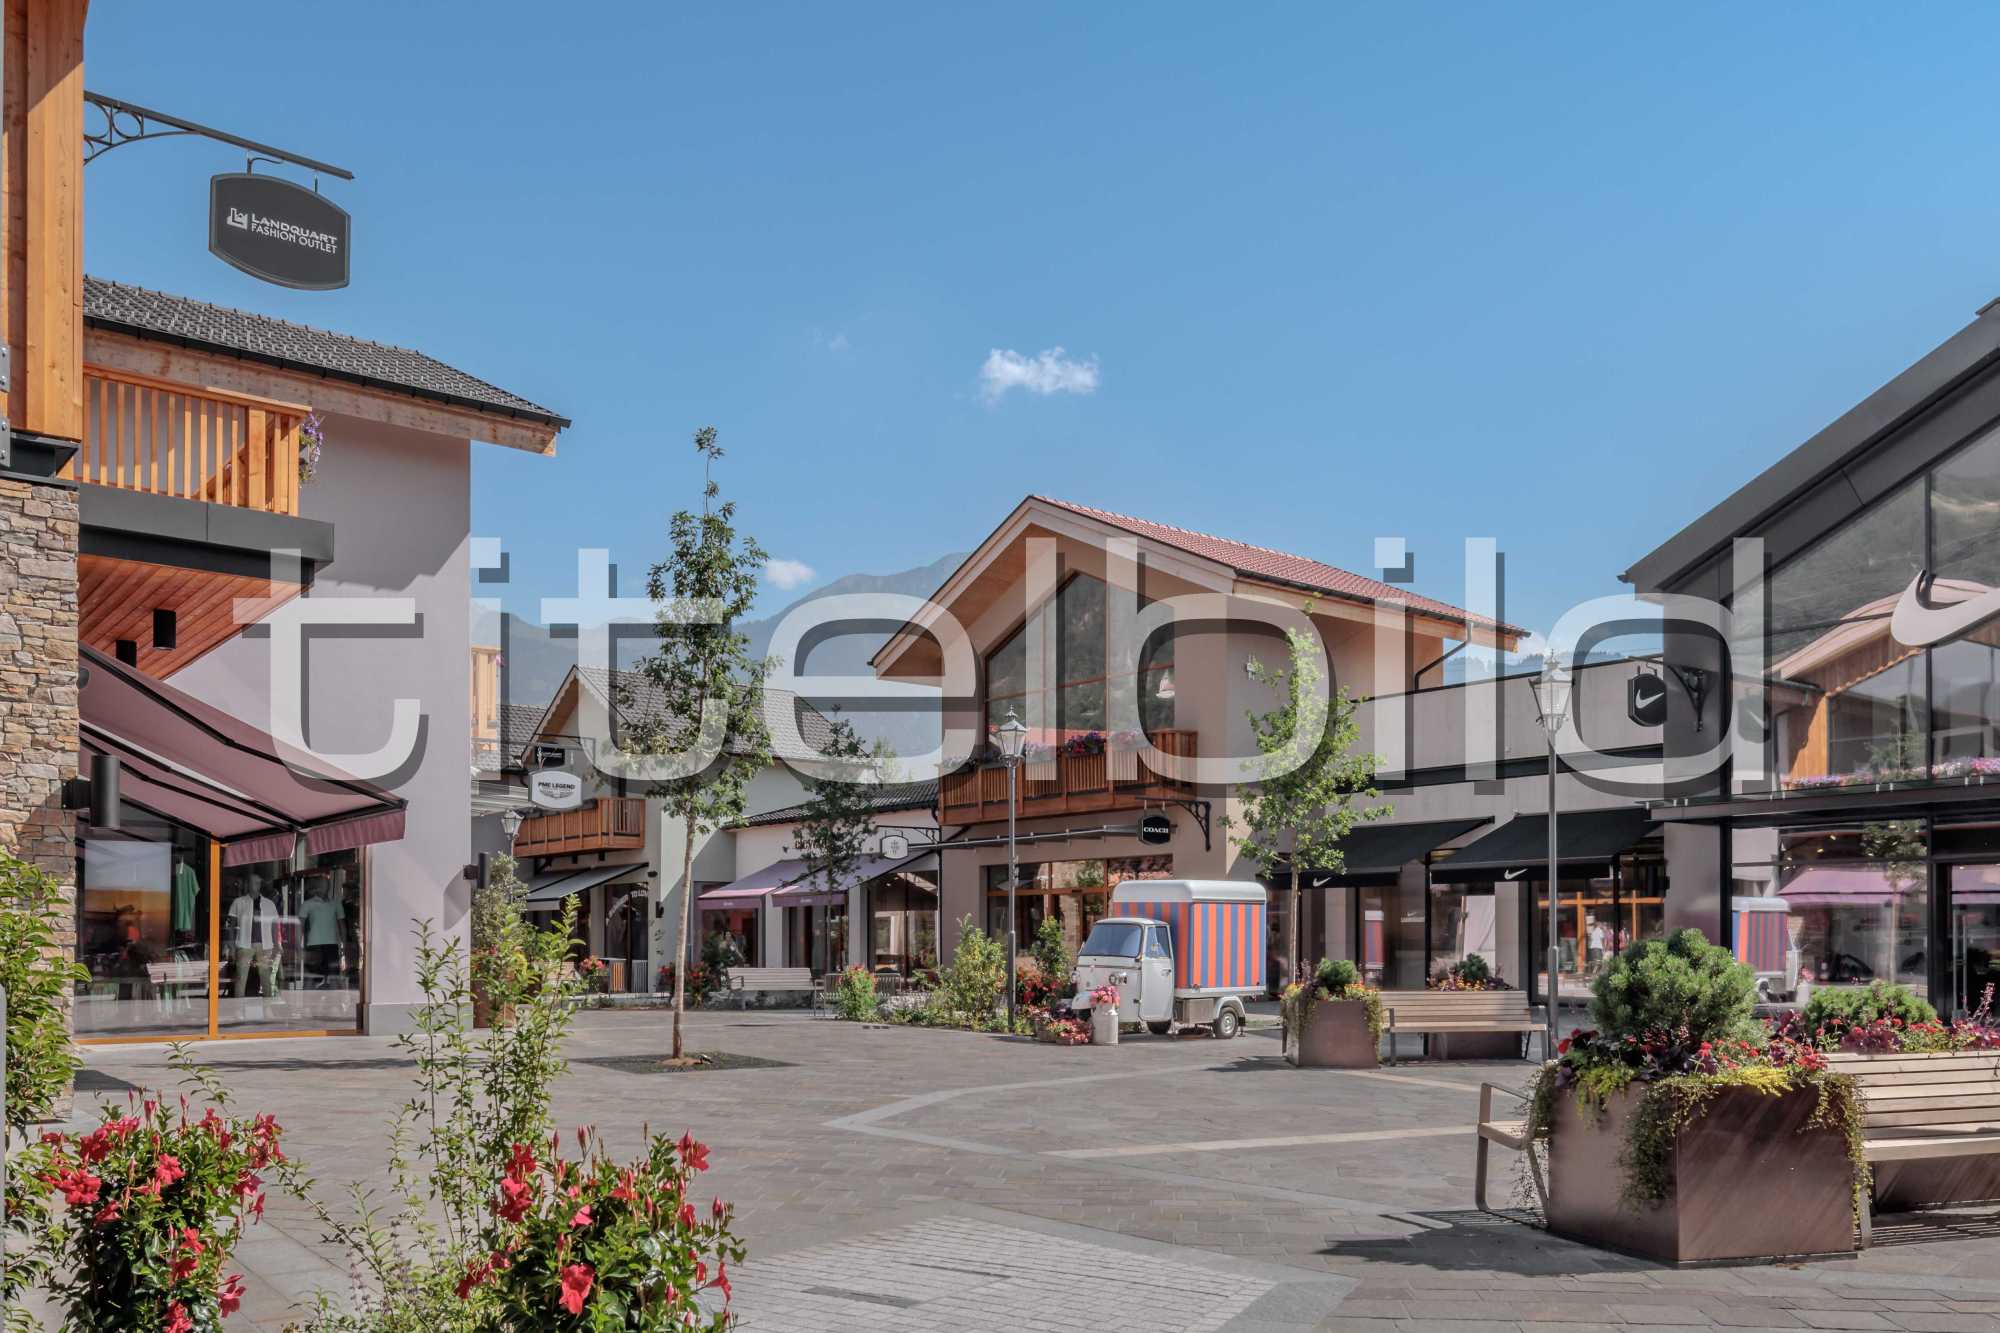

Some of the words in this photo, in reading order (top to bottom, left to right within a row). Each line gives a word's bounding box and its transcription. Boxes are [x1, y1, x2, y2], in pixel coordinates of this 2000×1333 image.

[251, 213, 338, 245] LANDQUART
[251, 222, 296, 243] FASHION
[299, 236, 337, 254] OUTLET
[1143, 826, 1169, 834] COACH
